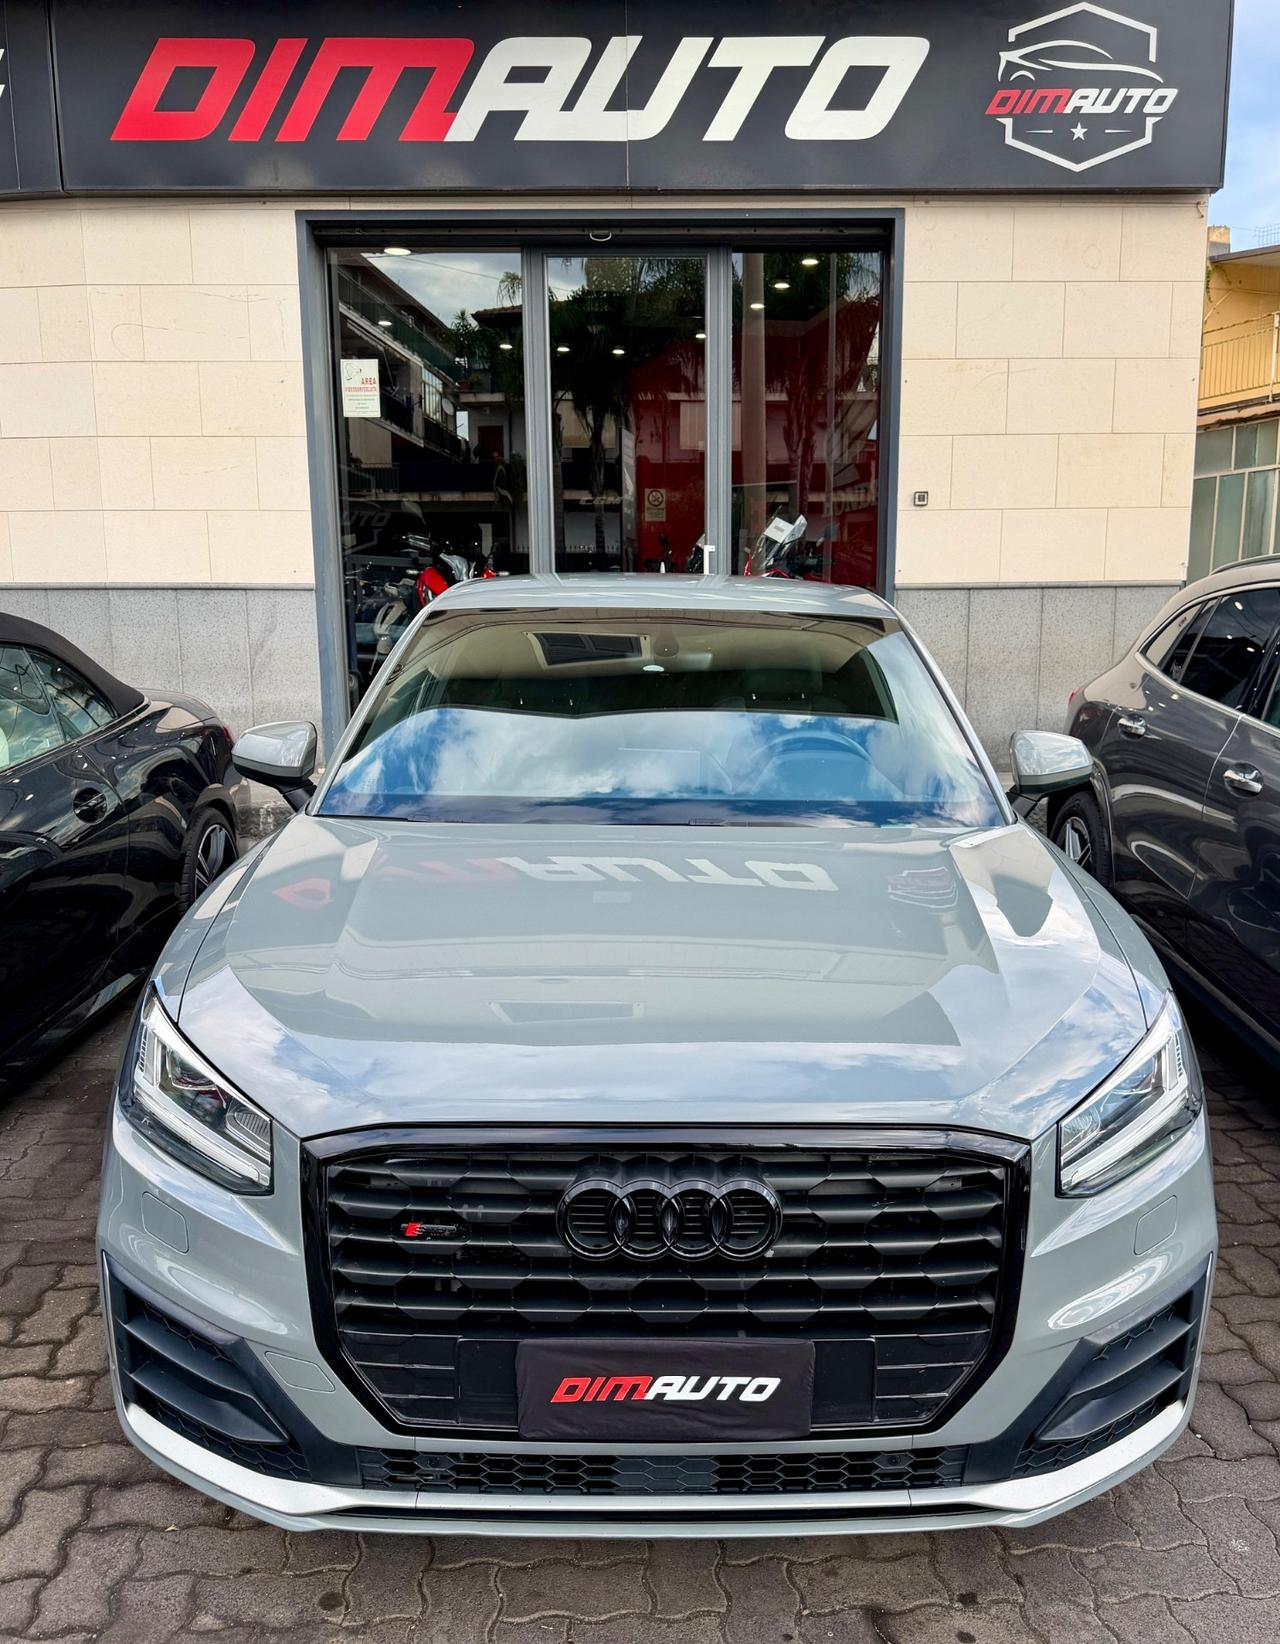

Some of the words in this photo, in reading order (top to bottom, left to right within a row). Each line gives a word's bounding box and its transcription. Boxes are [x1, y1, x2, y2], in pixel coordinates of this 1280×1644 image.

[111, 36, 931, 142] DIMAUTO
[985, 87, 1179, 116] DIMAUTO
[550, 1374, 781, 1404] DIMAUTO
